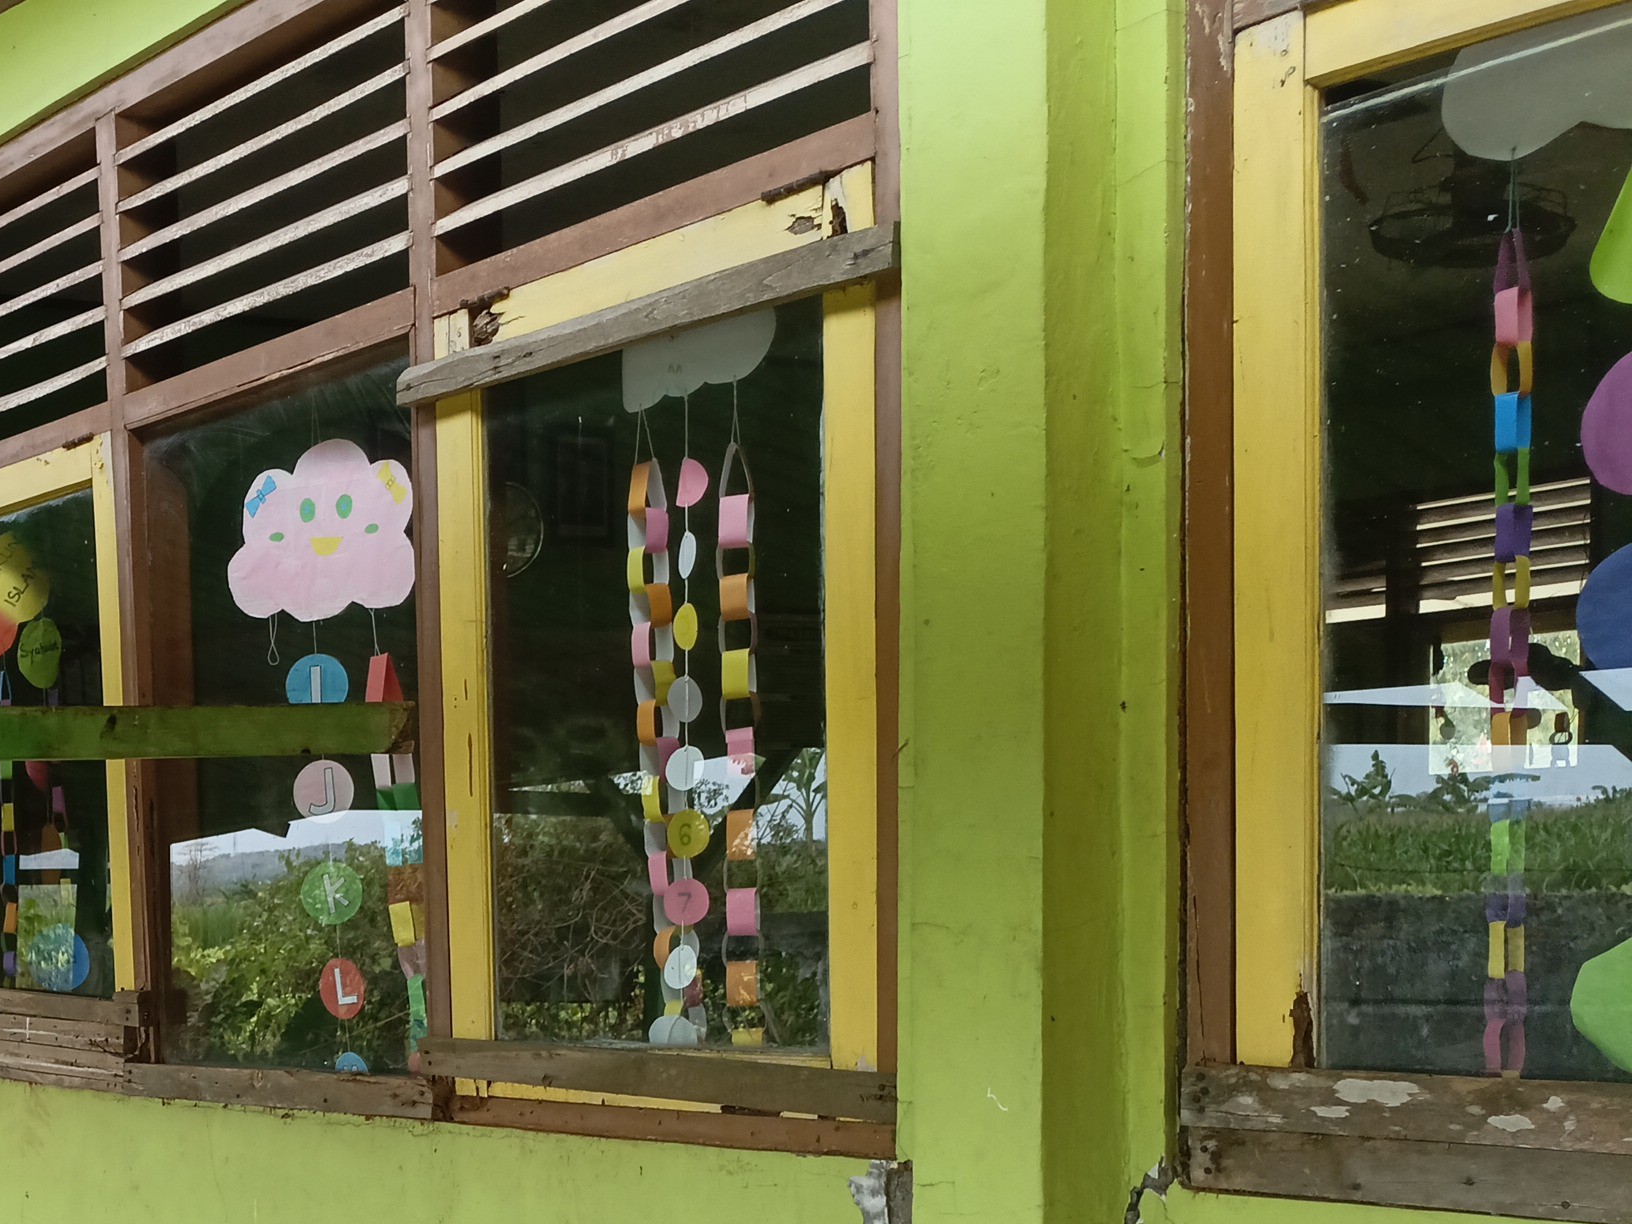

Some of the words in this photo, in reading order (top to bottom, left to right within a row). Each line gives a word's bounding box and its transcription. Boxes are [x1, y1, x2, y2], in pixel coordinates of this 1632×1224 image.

[308, 766, 336, 815] J
[678, 822, 692, 847] 6
[322, 872, 350, 915] K
[677, 891, 692, 913] 7
[334, 966, 358, 1006] L
